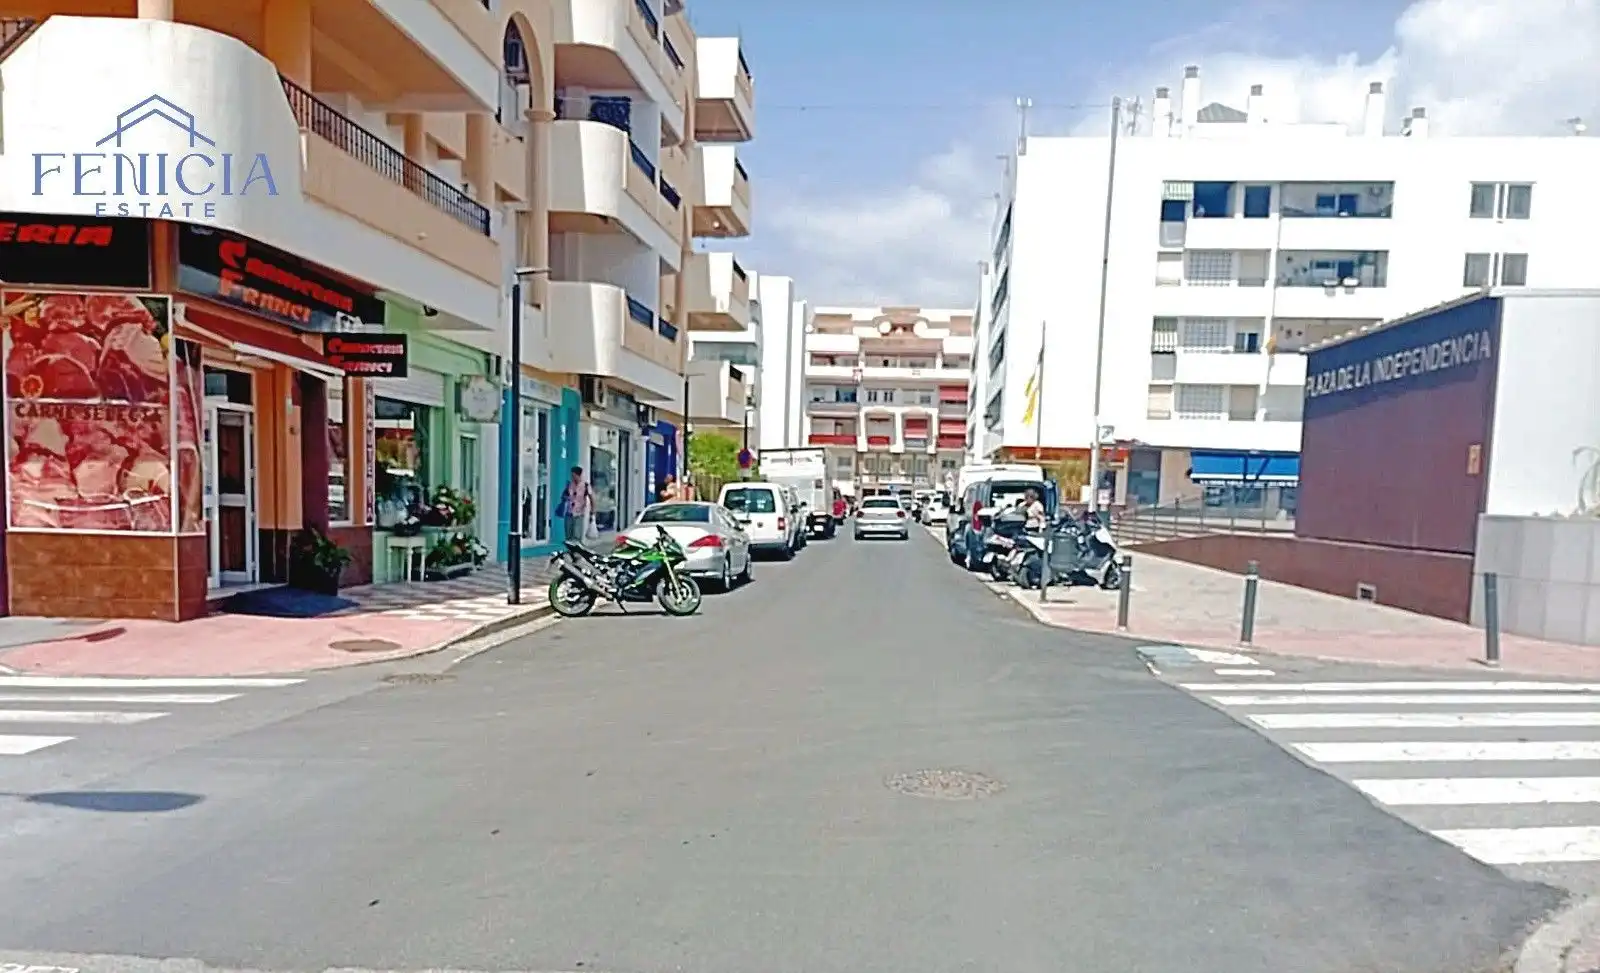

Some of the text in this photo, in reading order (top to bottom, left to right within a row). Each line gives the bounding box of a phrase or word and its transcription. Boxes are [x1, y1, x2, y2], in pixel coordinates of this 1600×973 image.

[1306, 330, 1492, 397] PLAZA DE LA INDEPENDENCIA
